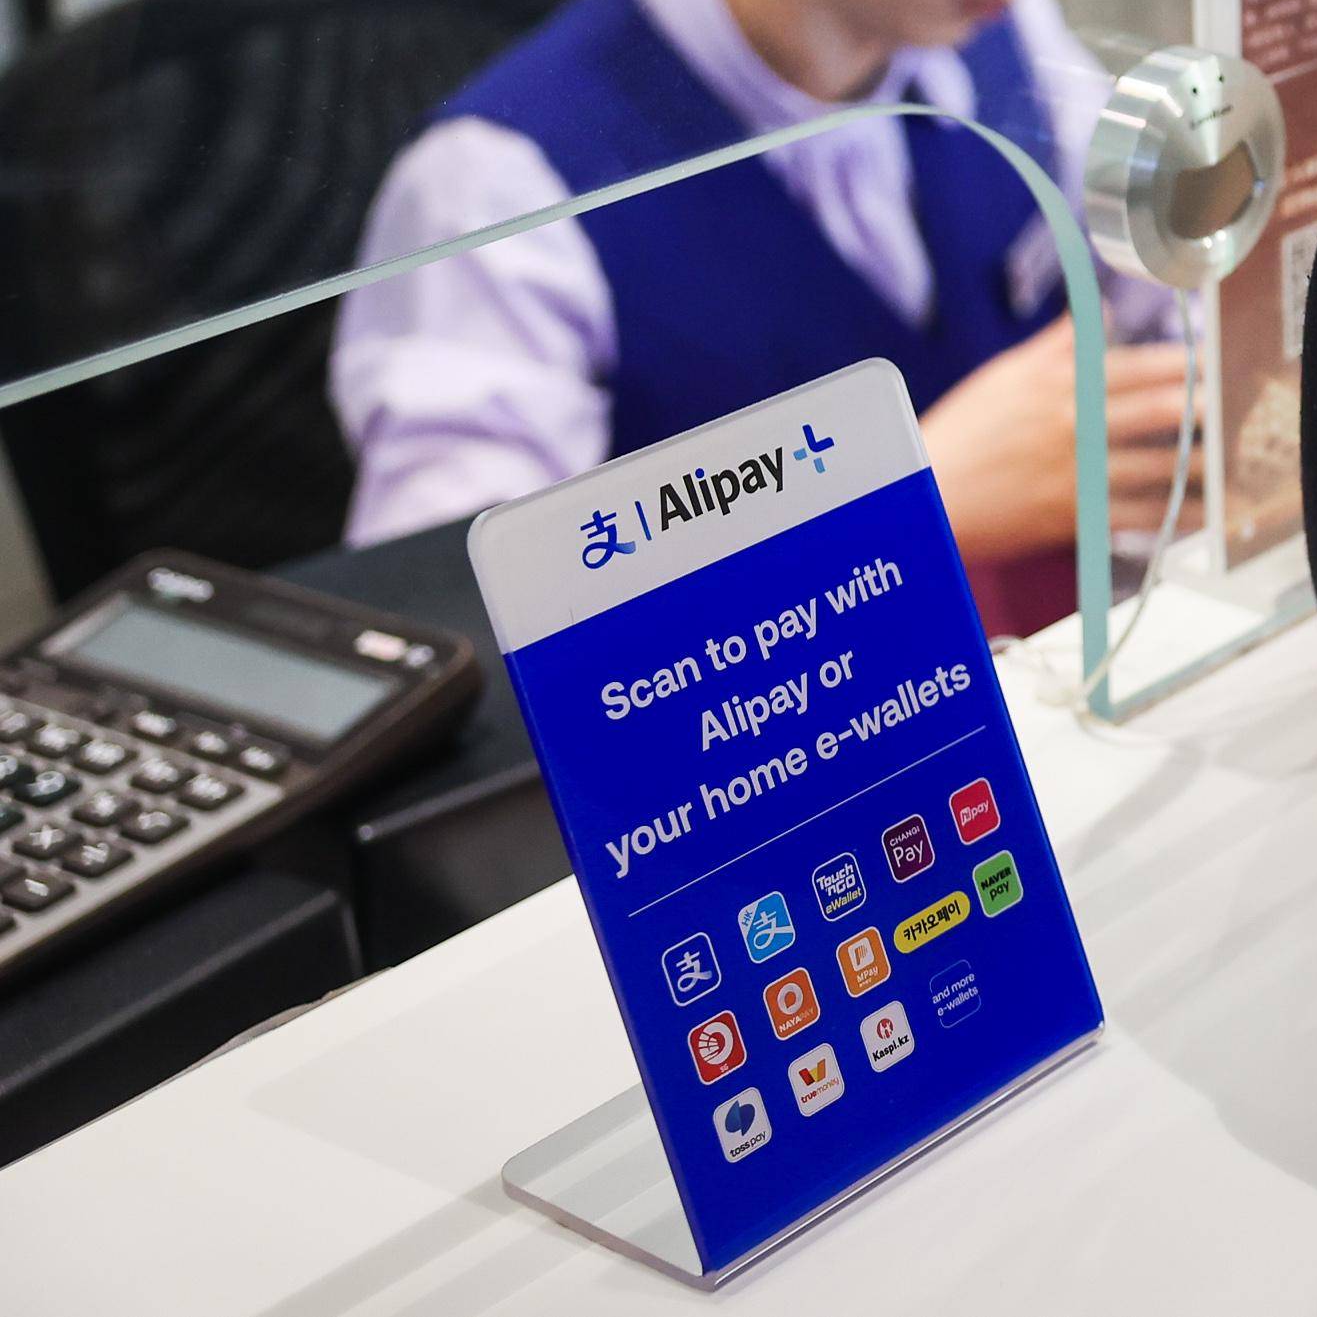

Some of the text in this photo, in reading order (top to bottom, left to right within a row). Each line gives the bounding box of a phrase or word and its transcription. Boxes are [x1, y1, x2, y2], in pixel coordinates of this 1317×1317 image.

[601, 558, 903, 720] Scan to pay with
[701, 650, 854, 752] Alipay or
[605, 663, 971, 879] your home e-wallets
[889, 825, 921, 847] CHANGI
[893, 840, 924, 868] Pay
[816, 863, 854, 890] Touch
[980, 866, 1012, 891] NAVER
[825, 887, 862, 914] eWallet
[989, 880, 1010, 902] pay
[903, 899, 962, 941] 카카오페이
[932, 973, 976, 1004] and more
[937, 986, 979, 1017] e-wallets
[872, 1035, 910, 1062] Kaspi.kz
